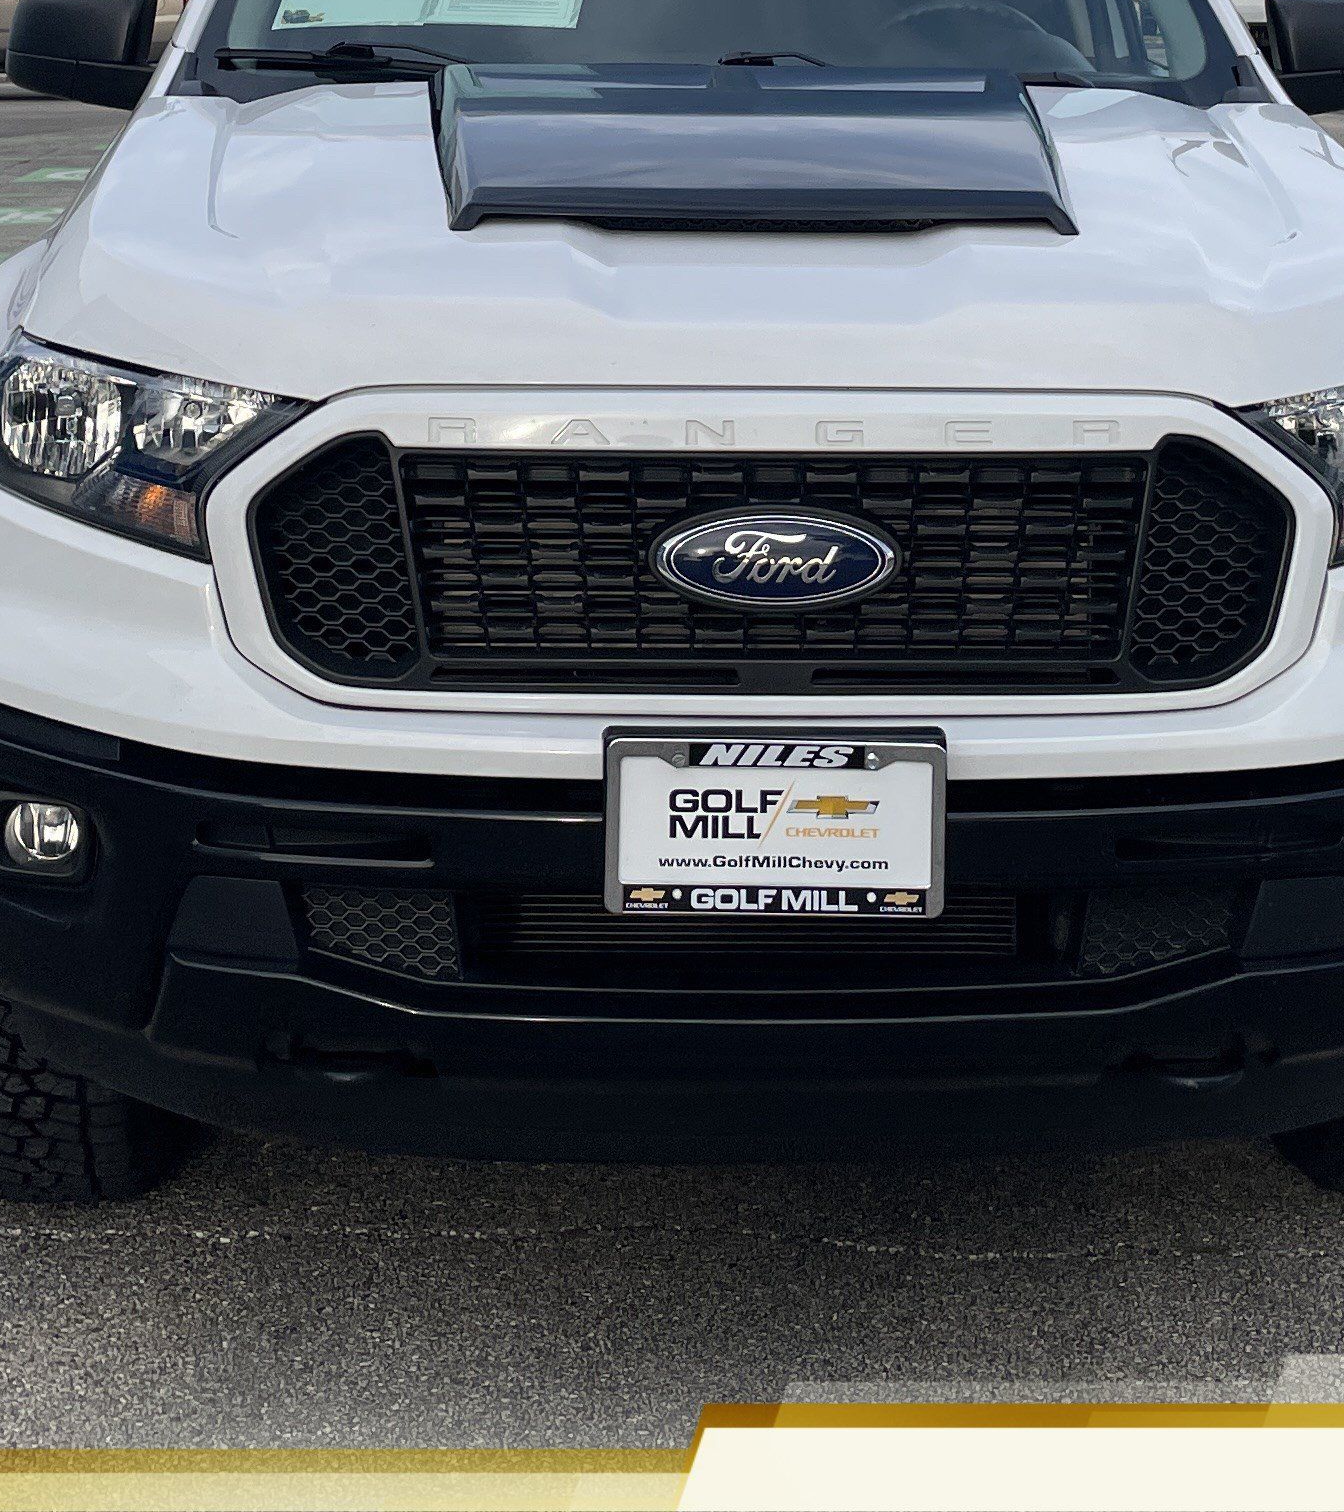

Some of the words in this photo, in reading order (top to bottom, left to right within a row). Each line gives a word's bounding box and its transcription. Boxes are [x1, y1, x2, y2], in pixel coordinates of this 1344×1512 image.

[428, 417, 1122, 447] RANGER
[712, 530, 839, 584] Ford
[698, 743, 854, 767] NILES
[668, 788, 785, 814] GOLF
[668, 814, 762, 840] MILL
[785, 826, 881, 839] CHEVROLET
[658, 854, 890, 872] www.GolfMillChevy.com
[690, 888, 777, 911] GOLF
[781, 889, 859, 912] MILL
